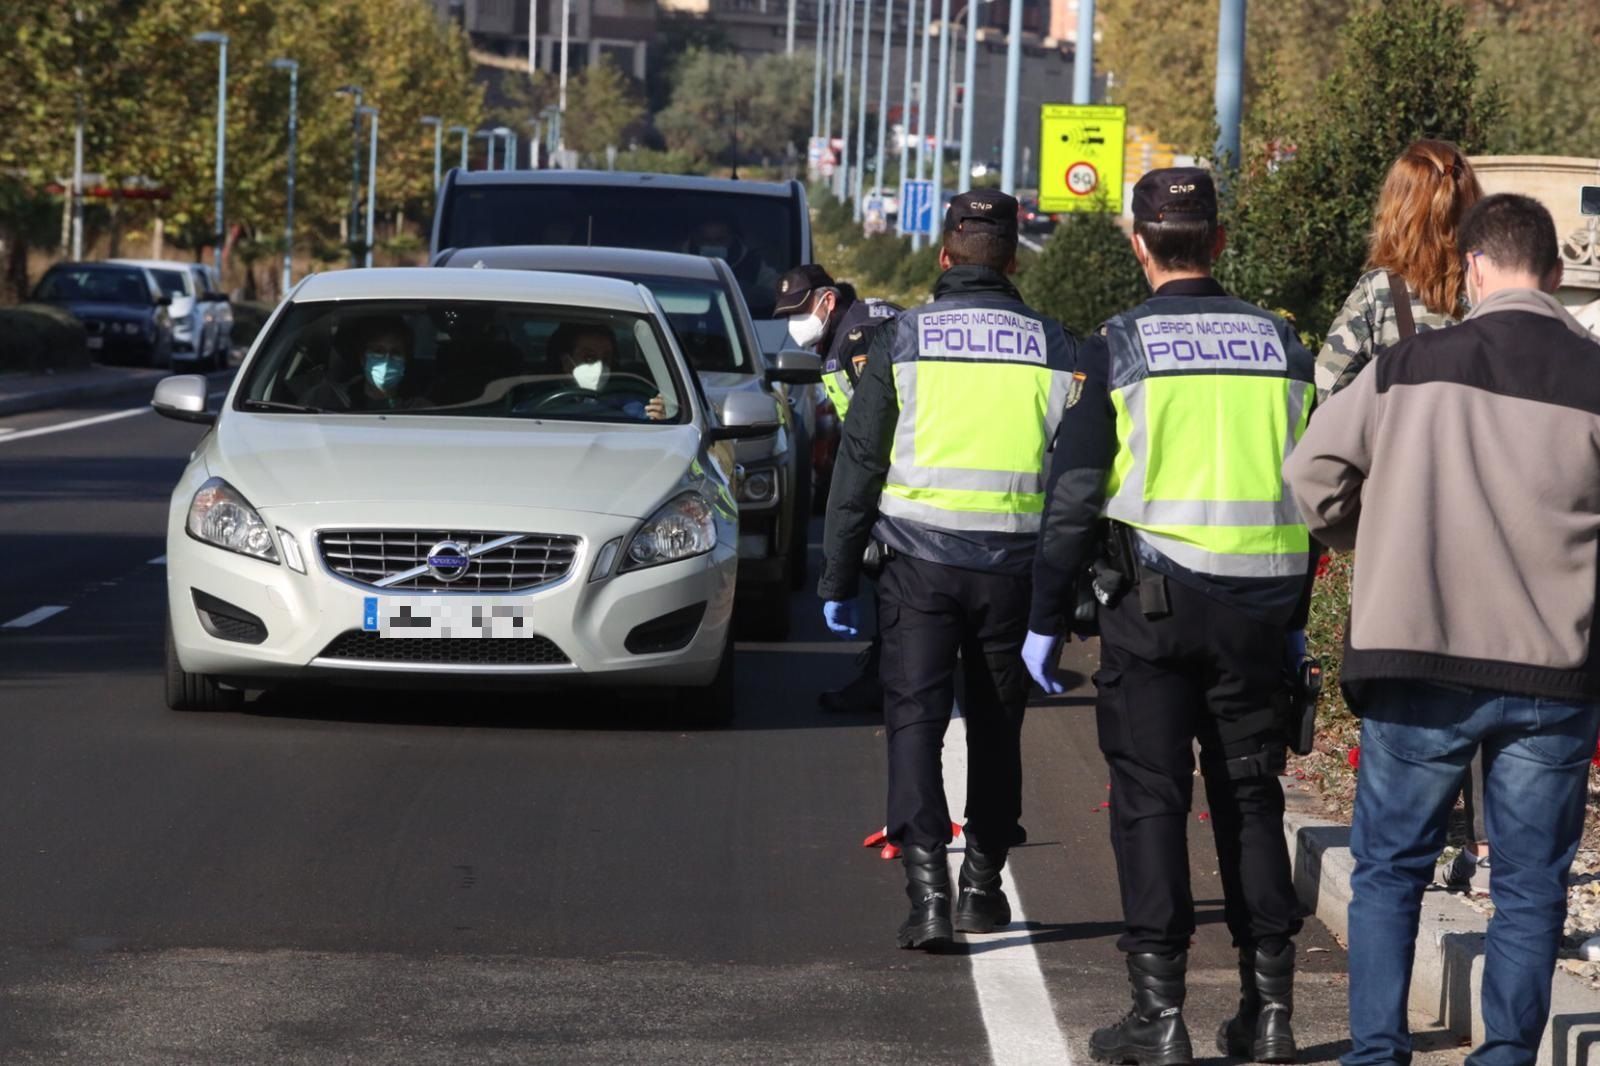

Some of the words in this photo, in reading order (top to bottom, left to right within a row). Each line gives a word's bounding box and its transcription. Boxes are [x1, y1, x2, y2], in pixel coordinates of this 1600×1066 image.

[1072, 173, 1091, 185] 50
[1170, 184, 1195, 193] CNP
[970, 201, 993, 210] CNP
[923, 313, 970, 326] CUERPO
[972, 313, 1024, 330] NACIONAL
[1025, 321, 1040, 333] DE
[1141, 321, 1194, 336] CUERPO
[1196, 321, 1258, 335] NACIONAL
[1258, 323, 1275, 336] DE
[923, 329, 1042, 357] POLICIA
[1147, 340, 1283, 363] POLICIA
[367, 617, 374, 625] E
